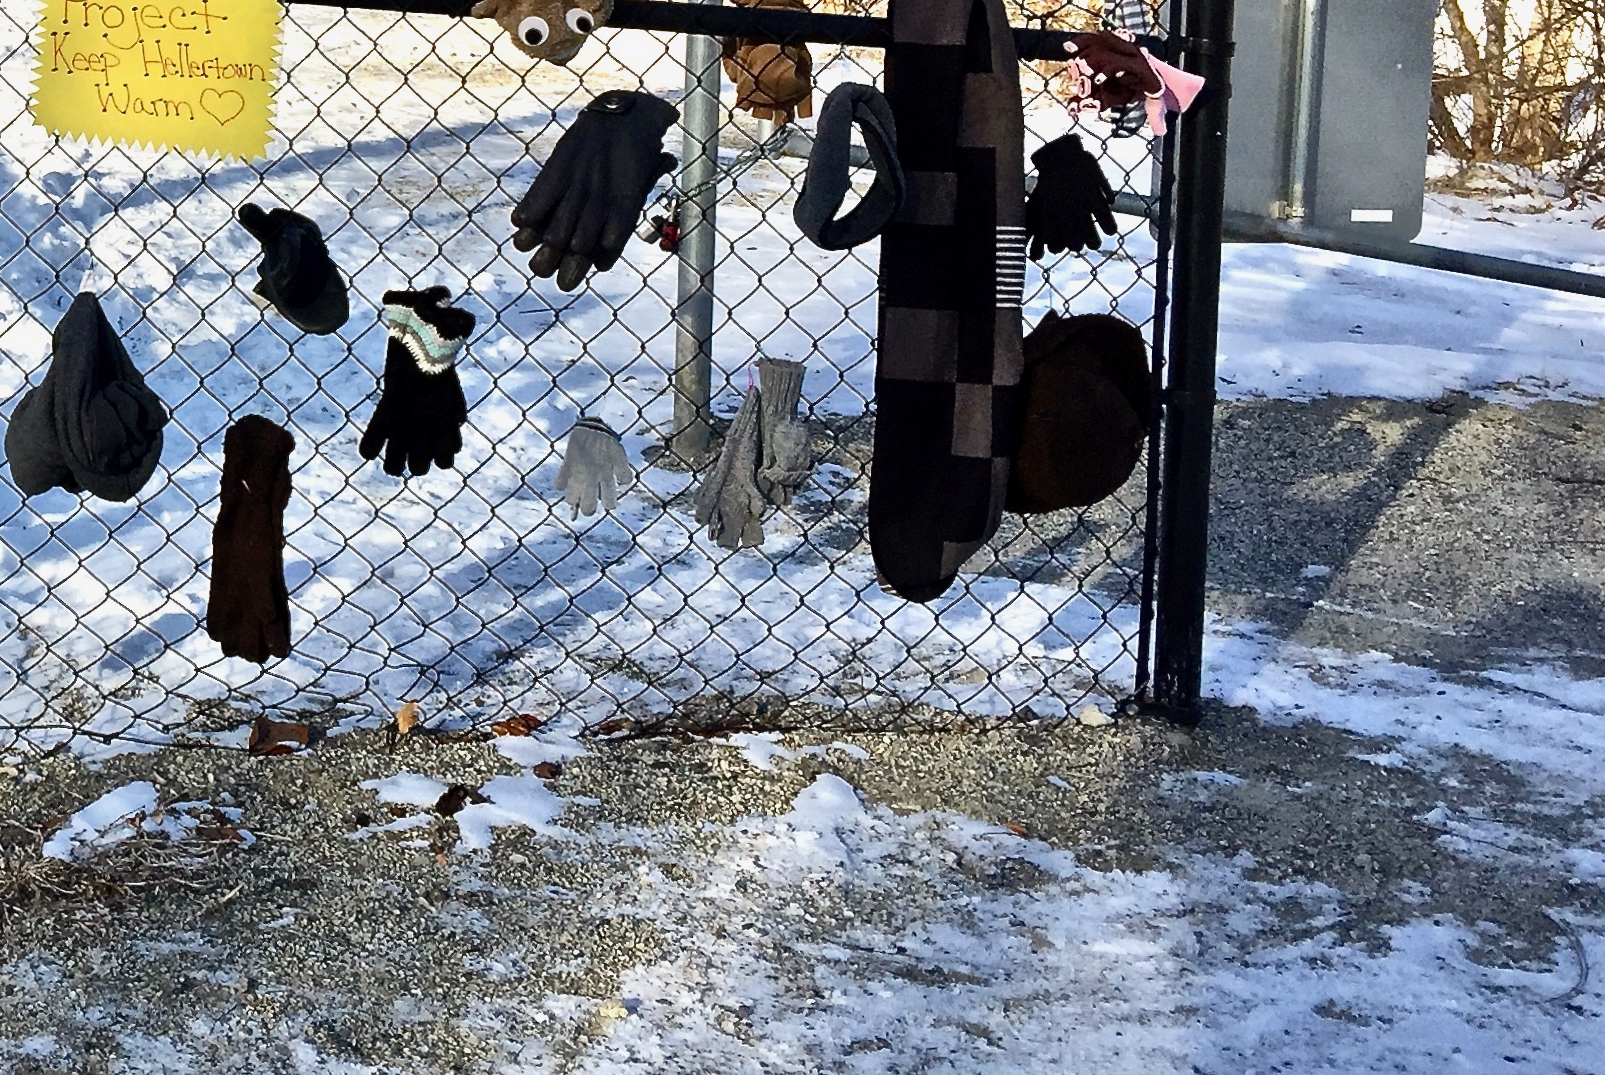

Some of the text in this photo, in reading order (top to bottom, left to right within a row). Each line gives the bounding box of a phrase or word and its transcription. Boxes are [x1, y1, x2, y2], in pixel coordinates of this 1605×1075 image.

[50, 31, 266, 86] Keep Hellertown
[94, 83, 195, 121] Warm
